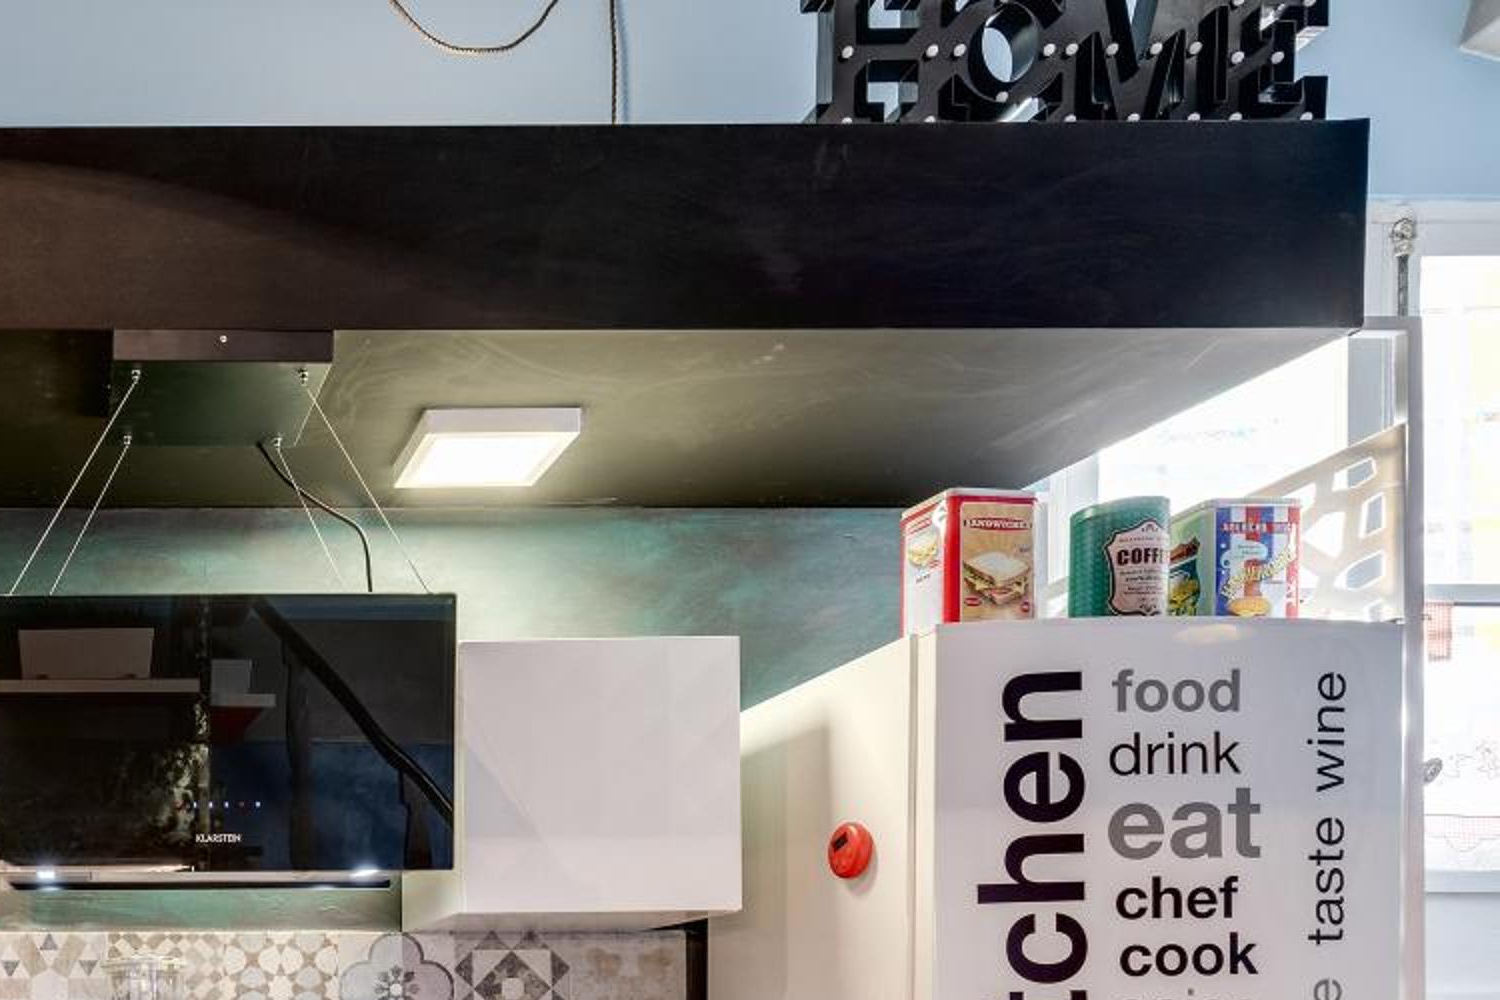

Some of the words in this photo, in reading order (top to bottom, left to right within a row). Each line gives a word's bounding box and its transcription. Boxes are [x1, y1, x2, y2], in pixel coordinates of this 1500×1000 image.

[814, 0, 1328, 121] HOME
[1112, 669, 1241, 712] food
[1110, 731, 1241, 776] drink
[1308, 672, 1347, 792] wine
[1108, 787, 1261, 860] eat
[1116, 876, 1239, 920] chef
[1308, 818, 1345, 945] taste
[1119, 932, 1258, 976] cook
